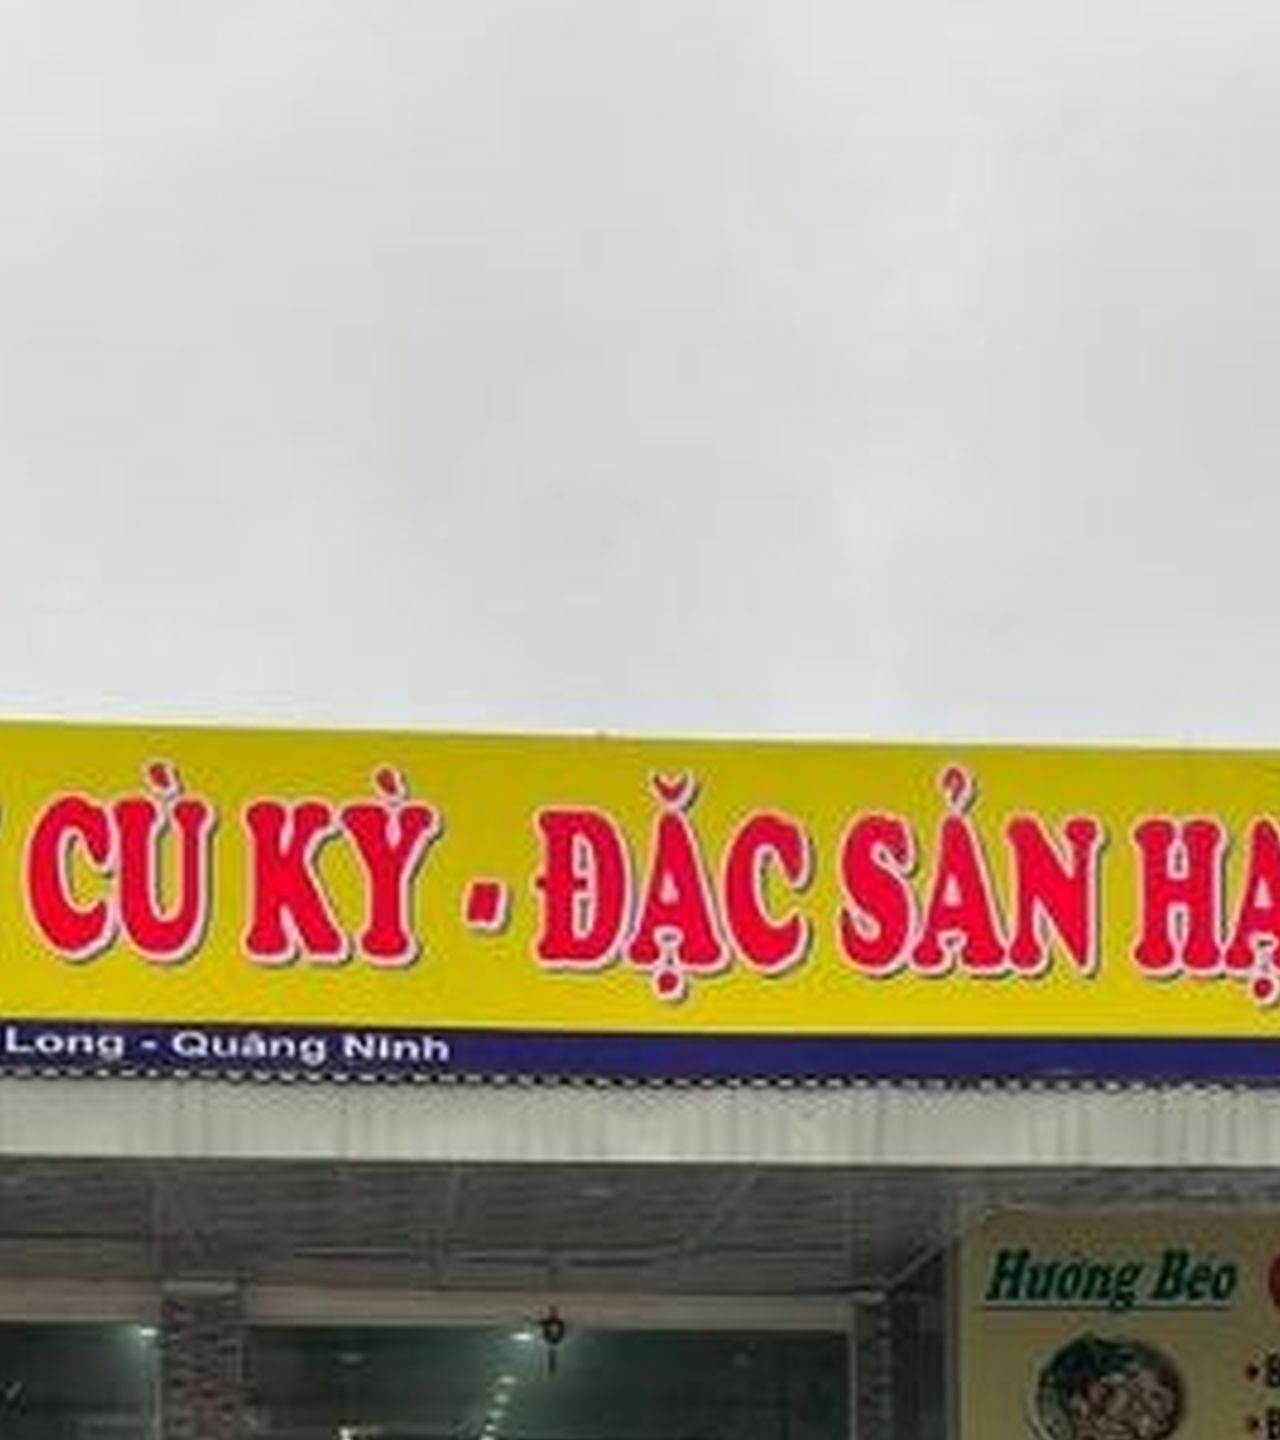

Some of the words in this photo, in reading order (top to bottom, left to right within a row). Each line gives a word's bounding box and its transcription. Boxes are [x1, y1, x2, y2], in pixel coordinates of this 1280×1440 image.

[24, 759, 215, 964] CÙ
[243, 765, 440, 968] KỲ
[534, 771, 812, 1002] ĐẶC
[837, 765, 1104, 979] SẢN
[6, 1027, 125, 1061] Long
[342, 1034, 451, 1062] Ninh
